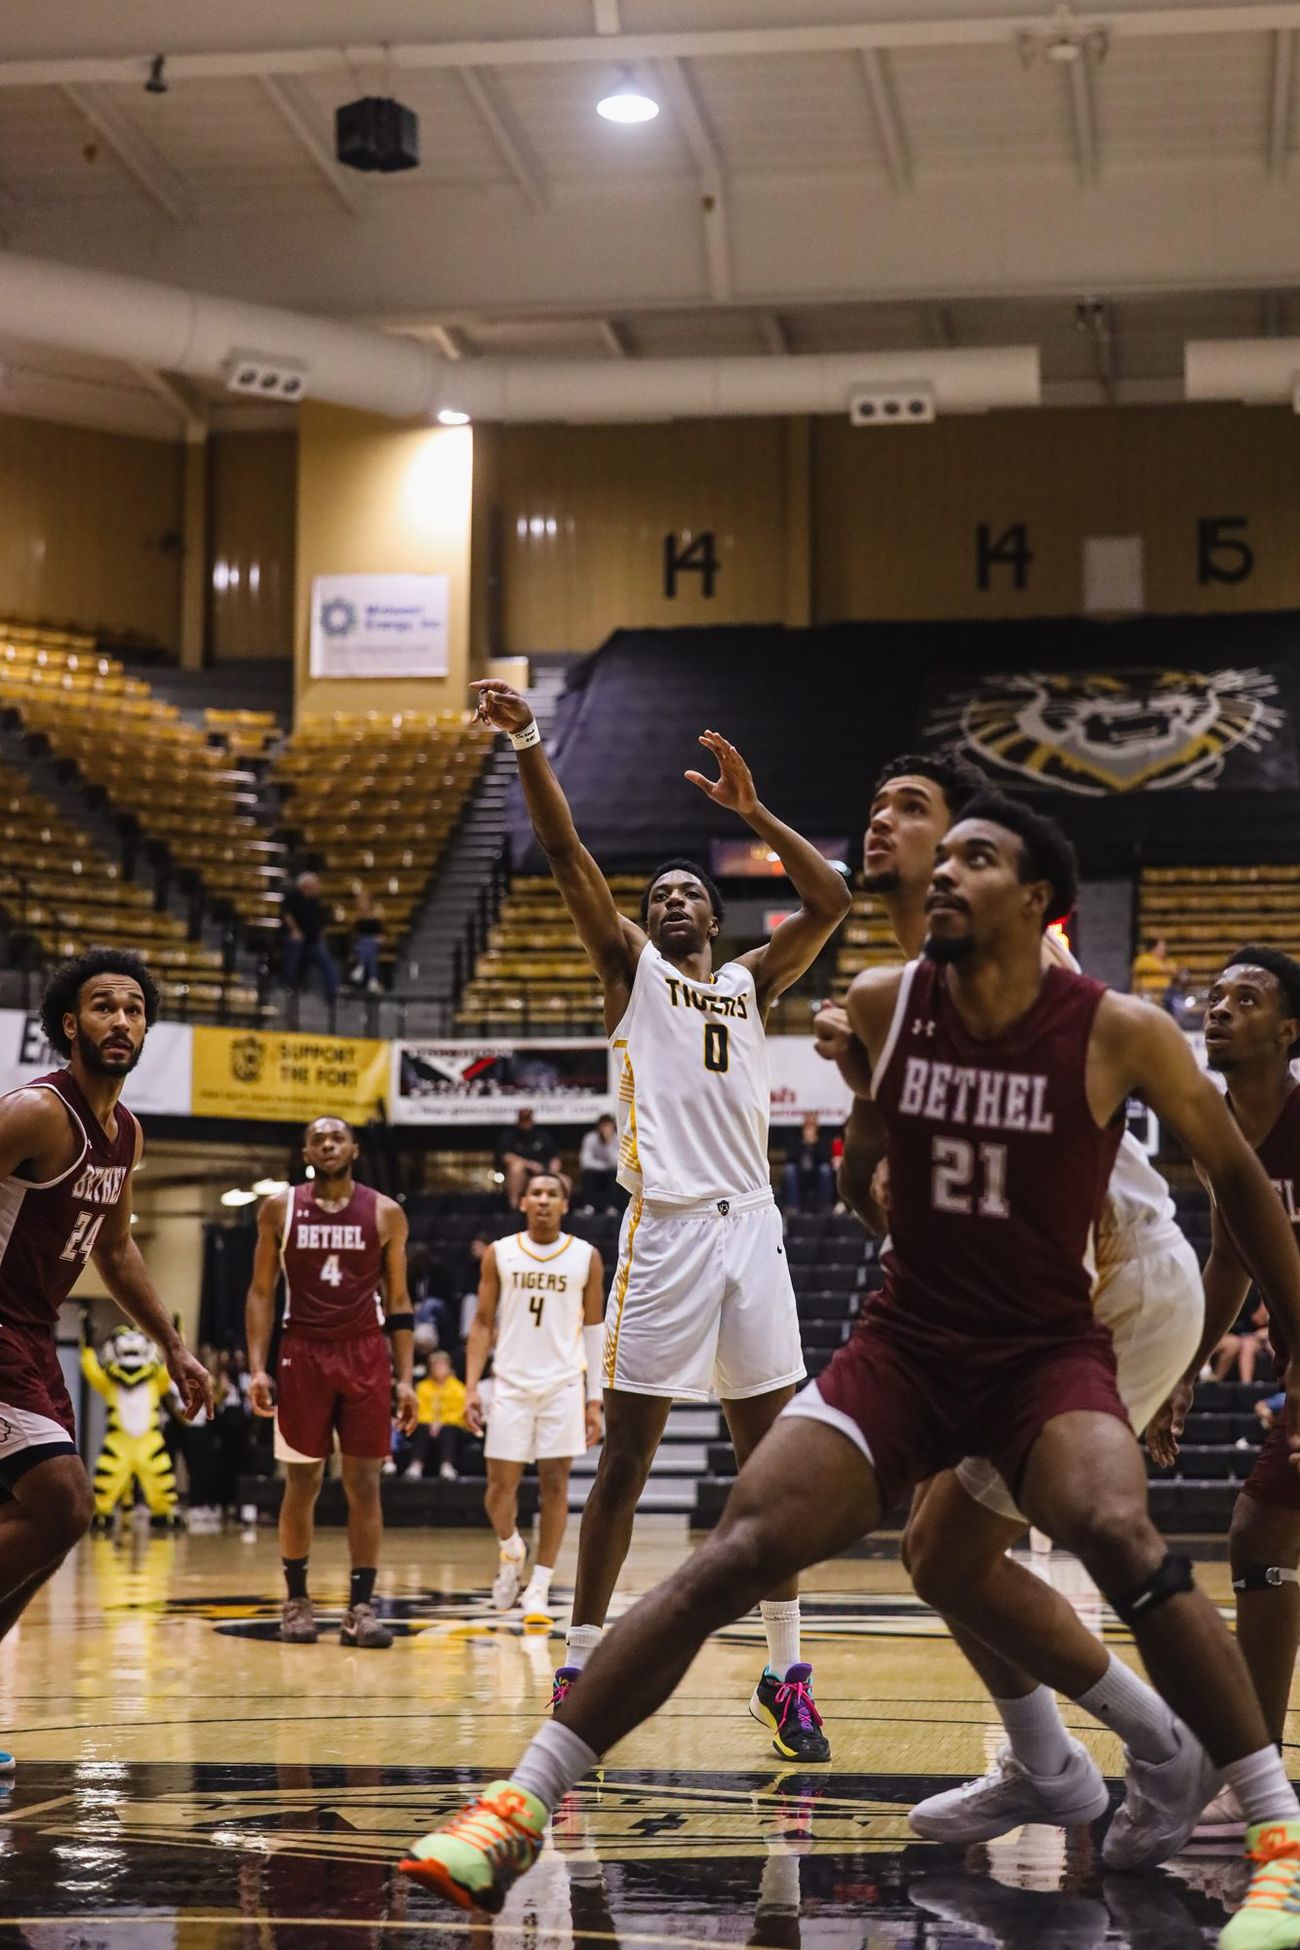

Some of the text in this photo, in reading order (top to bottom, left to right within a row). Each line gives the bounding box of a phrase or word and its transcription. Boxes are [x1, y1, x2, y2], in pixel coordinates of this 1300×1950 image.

[280, 1044, 355, 1063] SUPPORT
[704, 1023, 729, 1074] 0
[280, 1066, 357, 1087] THE FORT
[899, 1056, 1054, 1136] BETHEL
[932, 1135, 1009, 1219] 21
[297, 1224, 366, 1251] BETHEL
[320, 1254, 343, 1287] 4
[512, 1271, 568, 1293] TIGERS
[529, 1296, 545, 1327] 4
